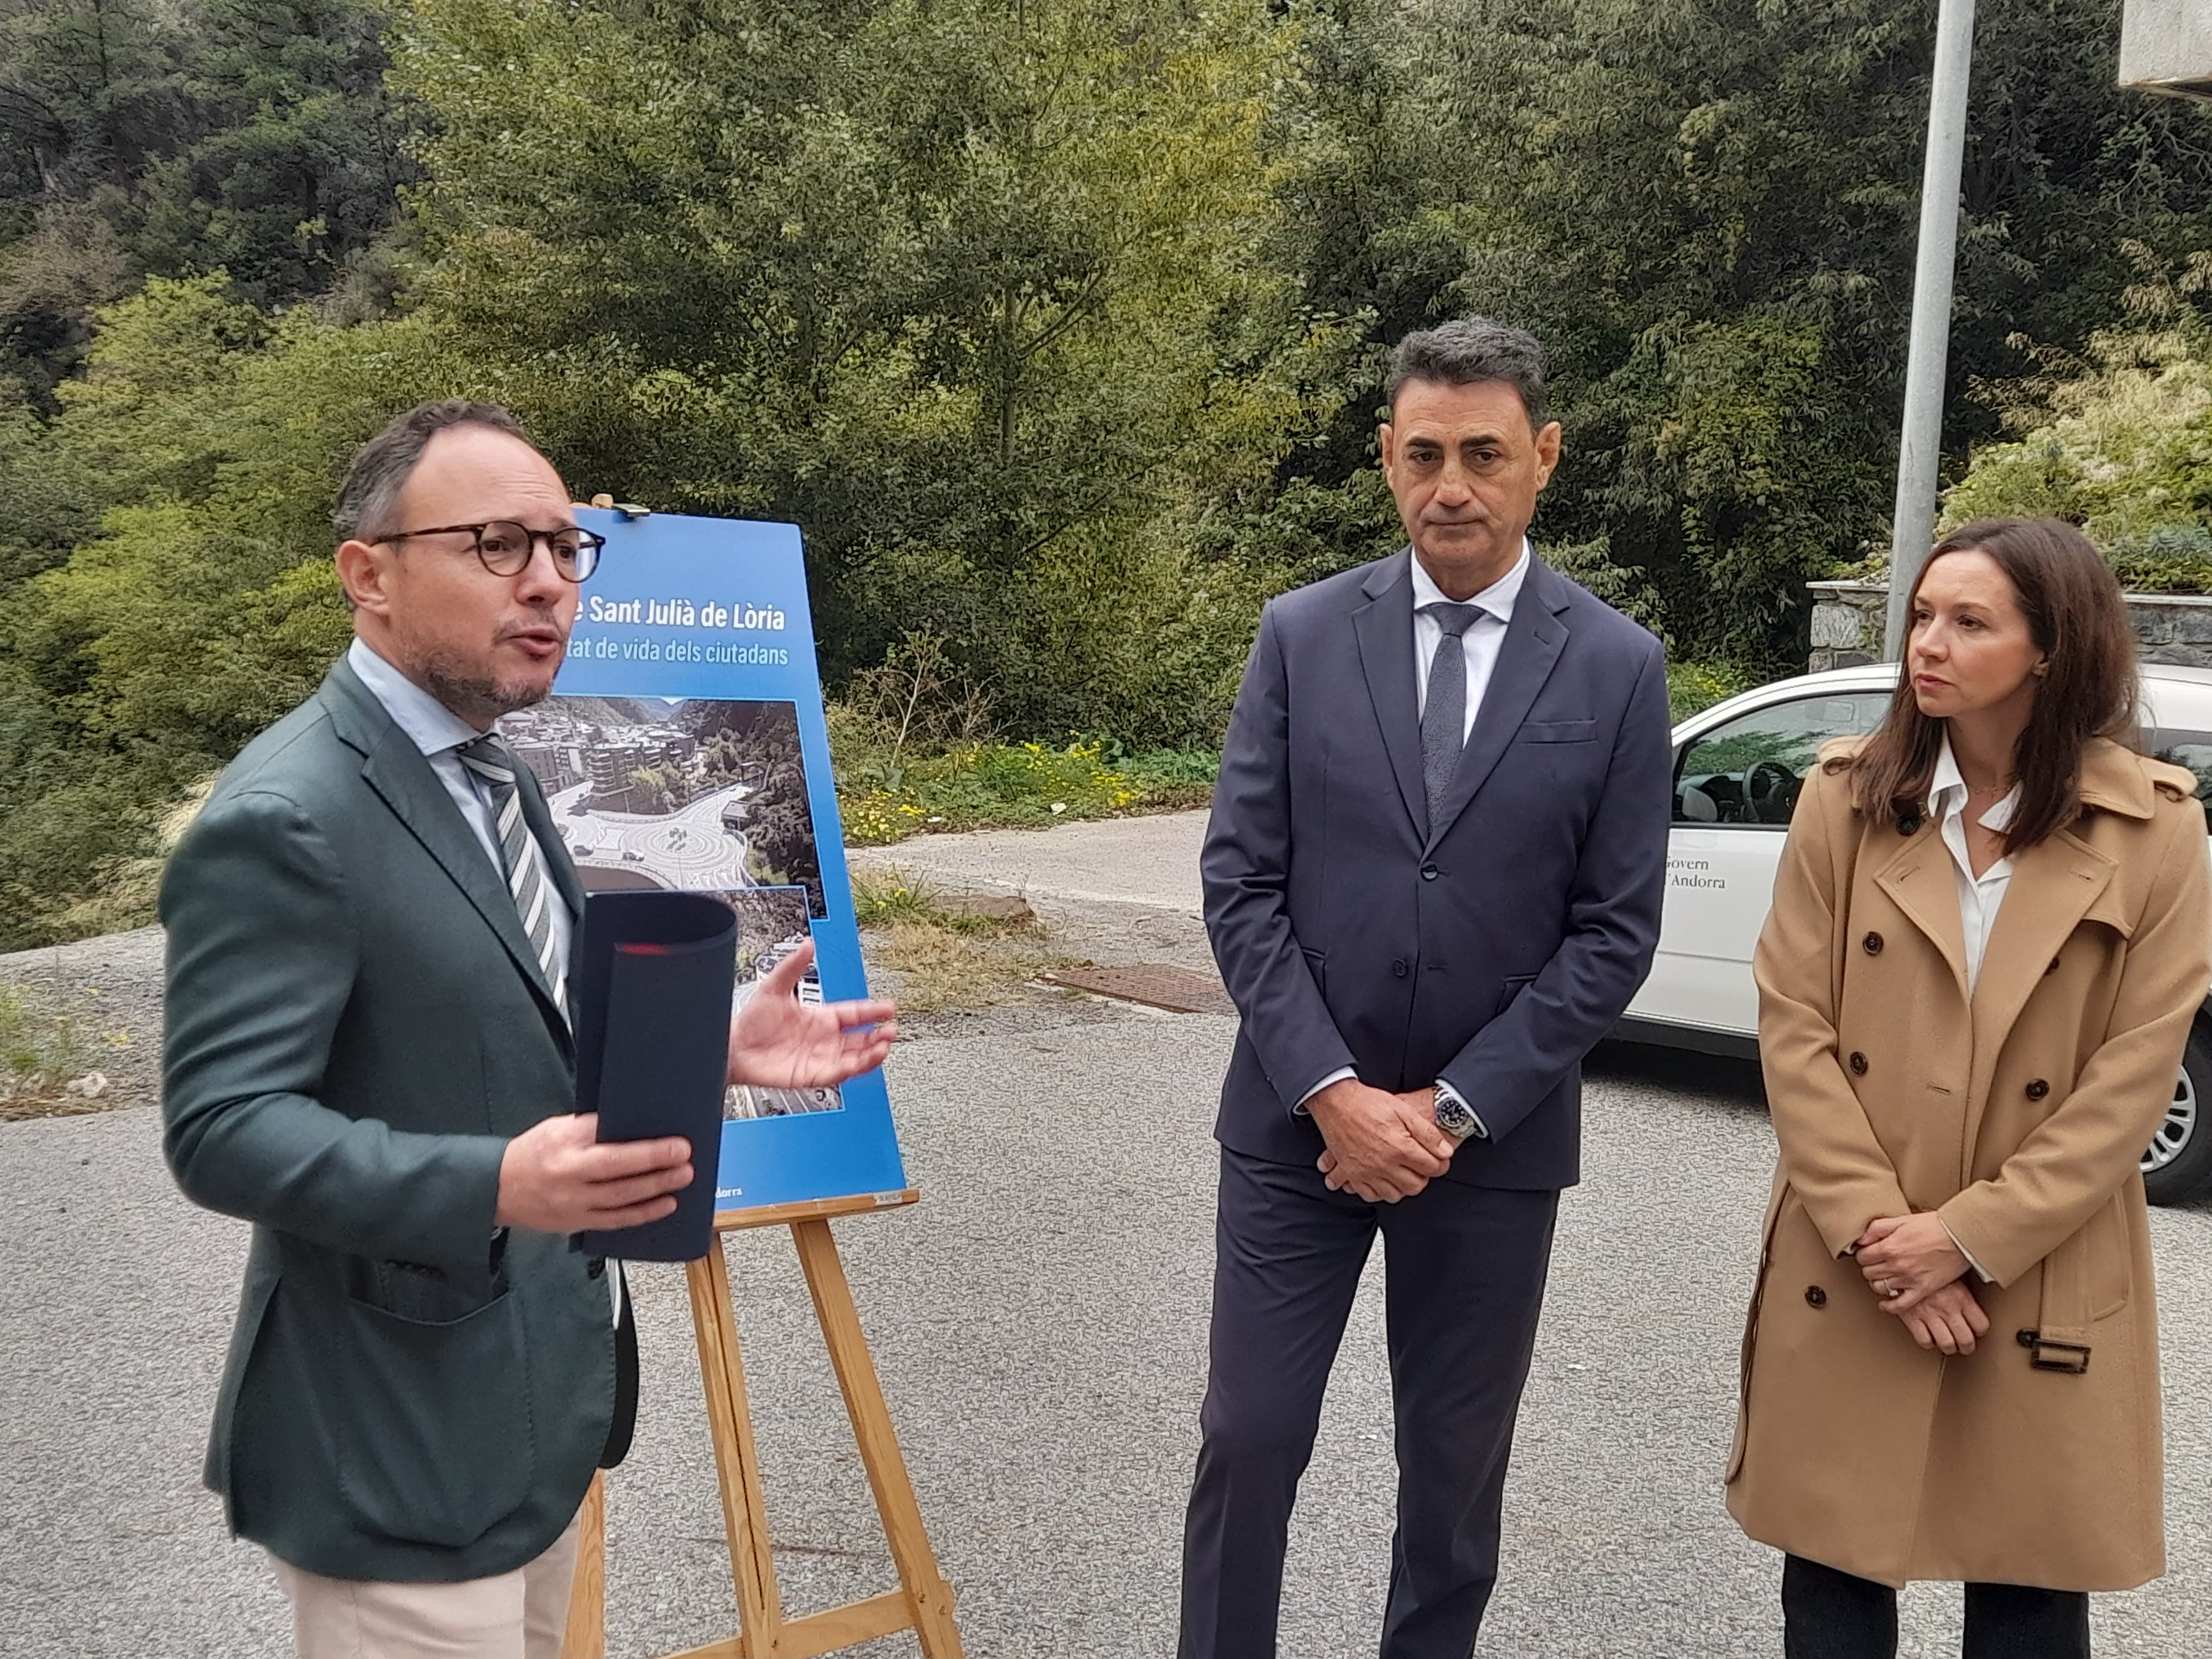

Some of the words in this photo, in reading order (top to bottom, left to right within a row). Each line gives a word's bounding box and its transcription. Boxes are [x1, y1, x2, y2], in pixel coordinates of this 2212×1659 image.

[589, 595, 641, 624] Sant
[645, 599, 695, 626] Julià
[701, 601, 727, 627] de
[733, 602, 785, 630] Lòria
[595, 636, 618, 659] de
[623, 638, 660, 660] vida
[665, 639, 701, 662] dels
[706, 641, 788, 665] ciutadans
